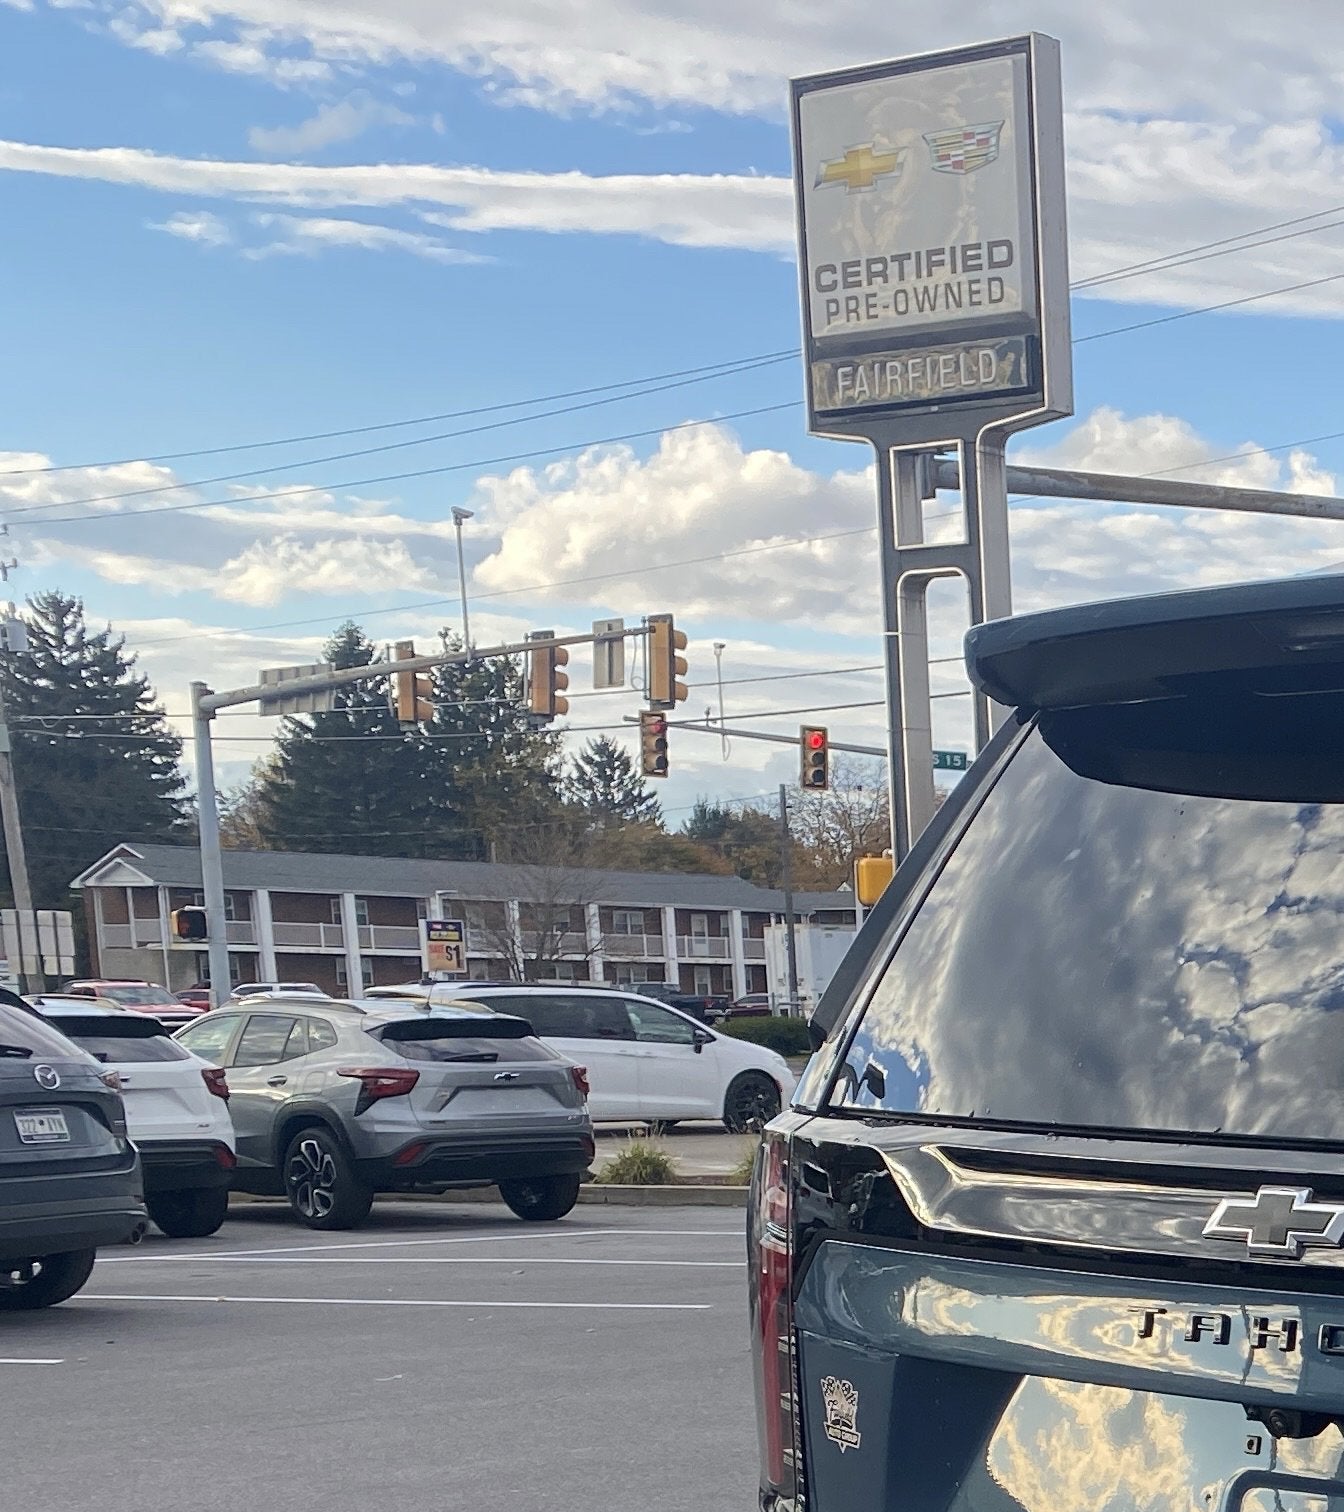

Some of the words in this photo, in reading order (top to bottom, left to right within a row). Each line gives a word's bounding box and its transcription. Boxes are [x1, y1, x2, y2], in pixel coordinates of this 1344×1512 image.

[814, 239, 1014, 293] CERTIFIED
[825, 276, 1005, 326] PRE-OWNED
[836, 348, 997, 401] FAIRFIELD
[946, 755, 962, 767] 15
